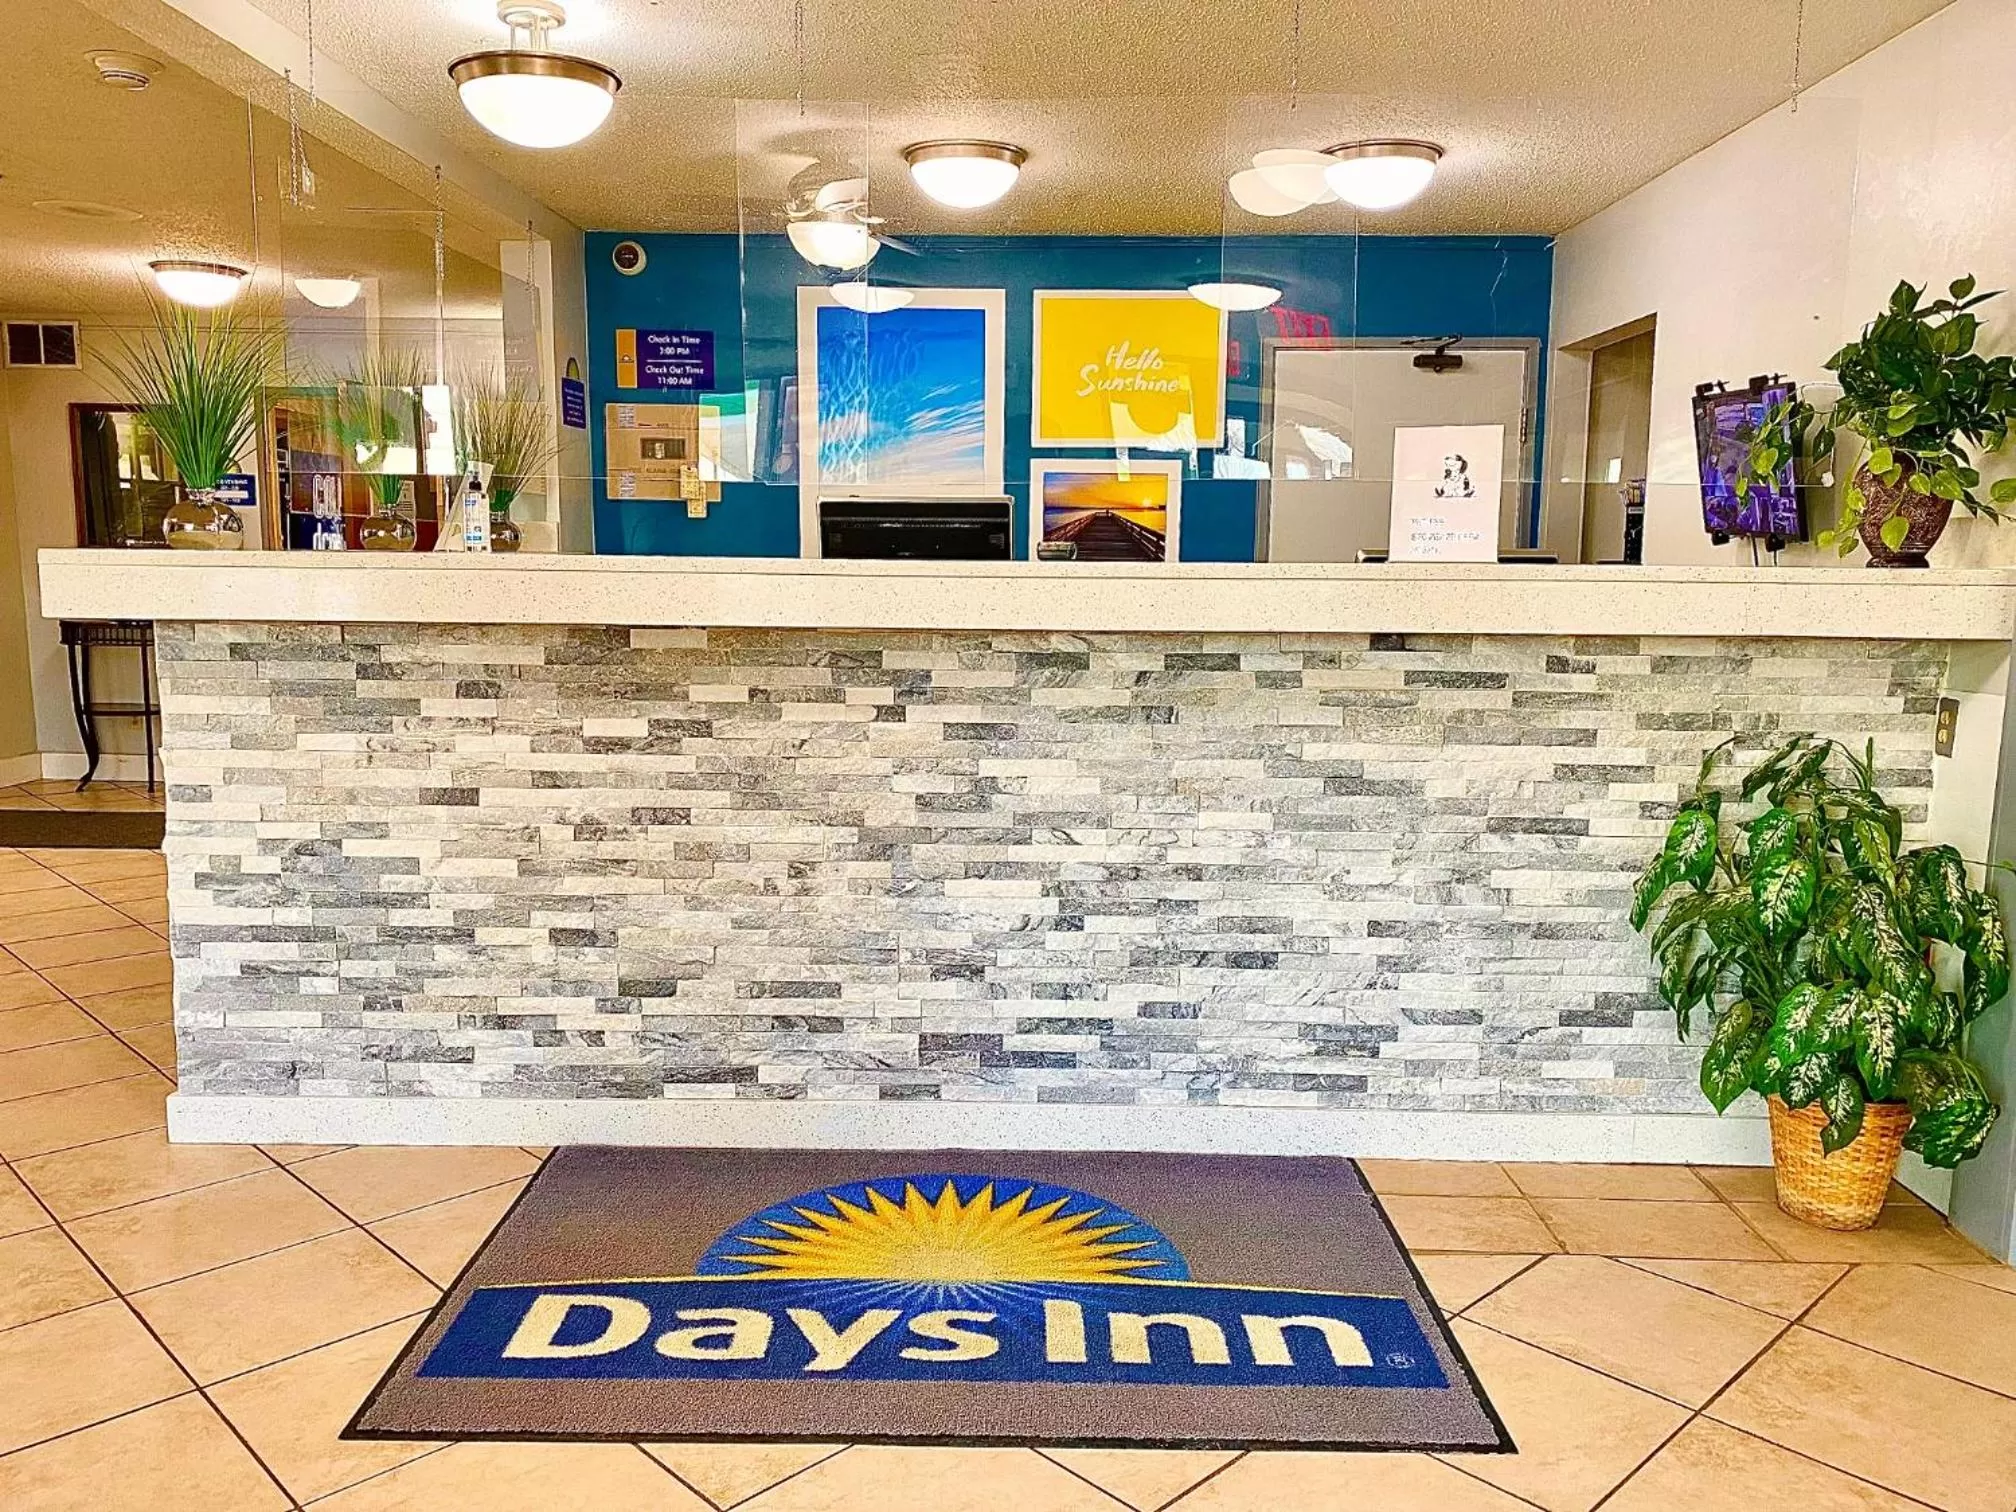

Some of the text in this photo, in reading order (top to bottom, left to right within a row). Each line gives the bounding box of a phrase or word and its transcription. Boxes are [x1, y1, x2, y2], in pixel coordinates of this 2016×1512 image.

[647, 334, 701, 345] Check In Time
[676, 347, 690, 355] PM
[1105, 339, 1164, 371] Hello
[645, 365, 704, 375] Check Out Time
[657, 376, 692, 385] 11:00 AM
[1076, 363, 1179, 397] Sunshine
[501, 1293, 1001, 1372] Days
[1042, 1298, 1375, 1368] Inn
